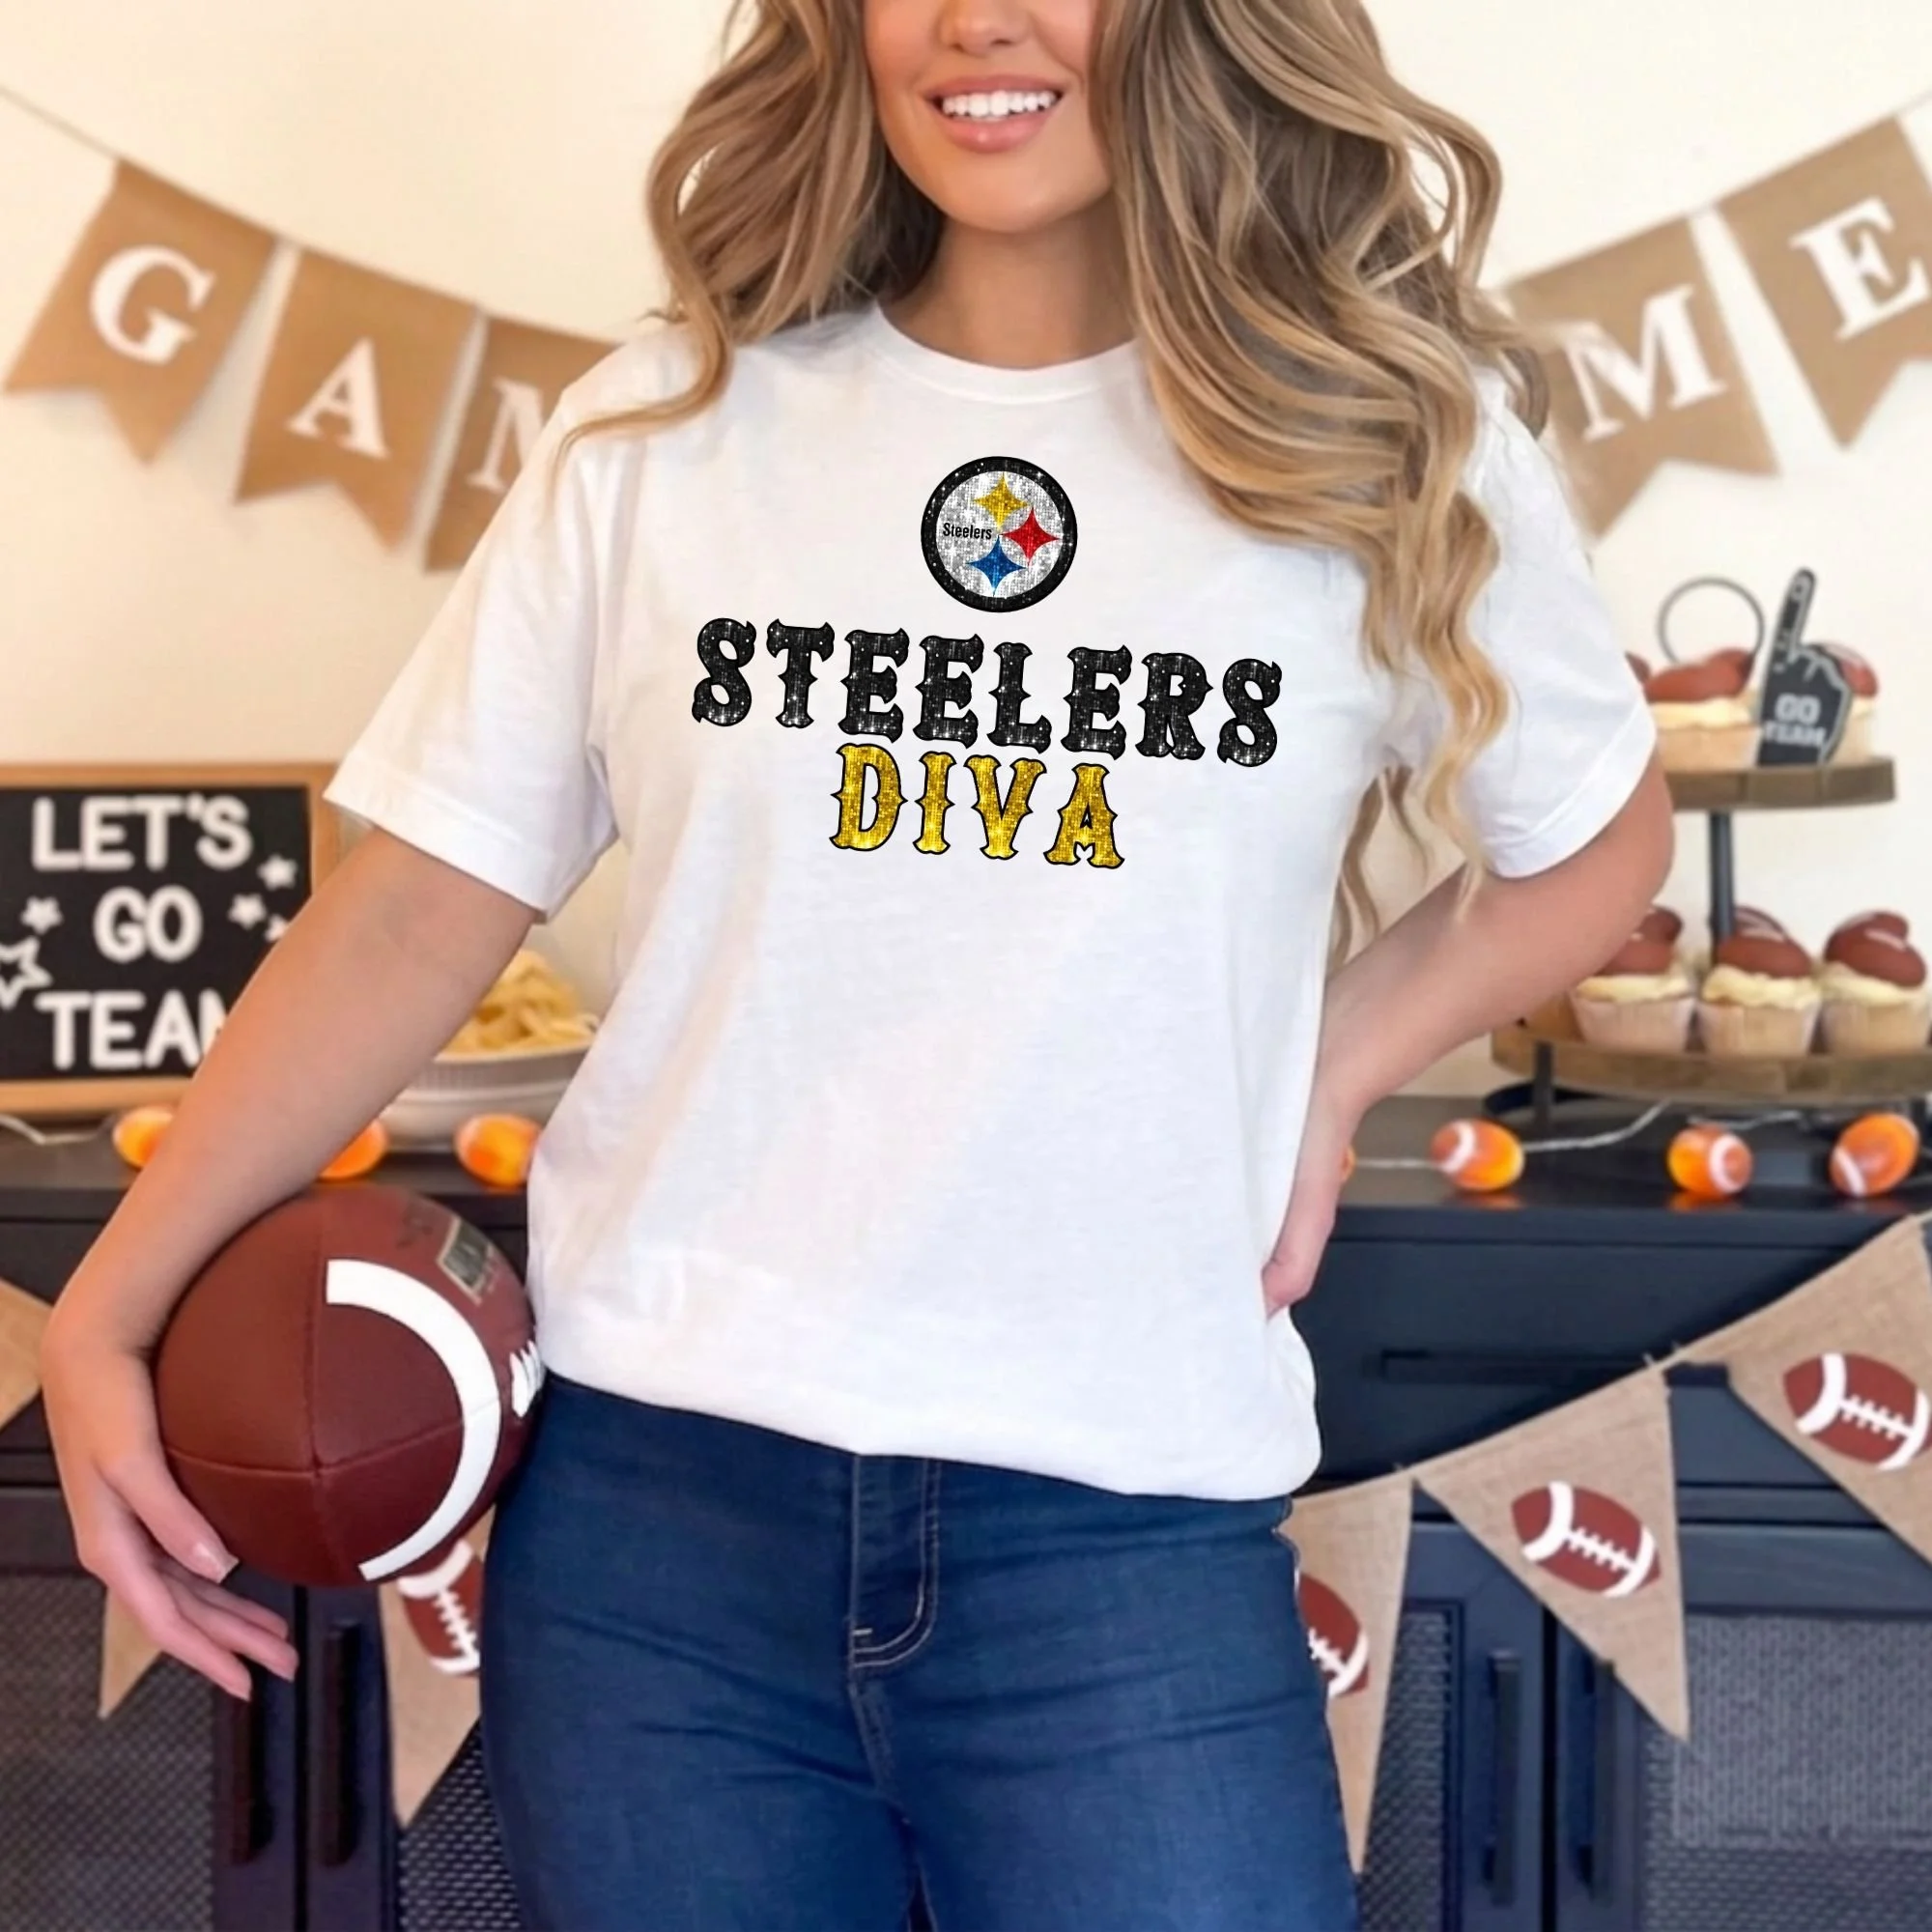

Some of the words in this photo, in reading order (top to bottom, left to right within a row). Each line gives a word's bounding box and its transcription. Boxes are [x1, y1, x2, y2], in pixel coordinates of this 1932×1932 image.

[943, 523, 992, 540] Steelers
[691, 617, 1283, 768] STEELERS
[31, 794, 253, 871] LET'S
[829, 743, 1125, 869] DIVA
[93, 885, 203, 963] GO
